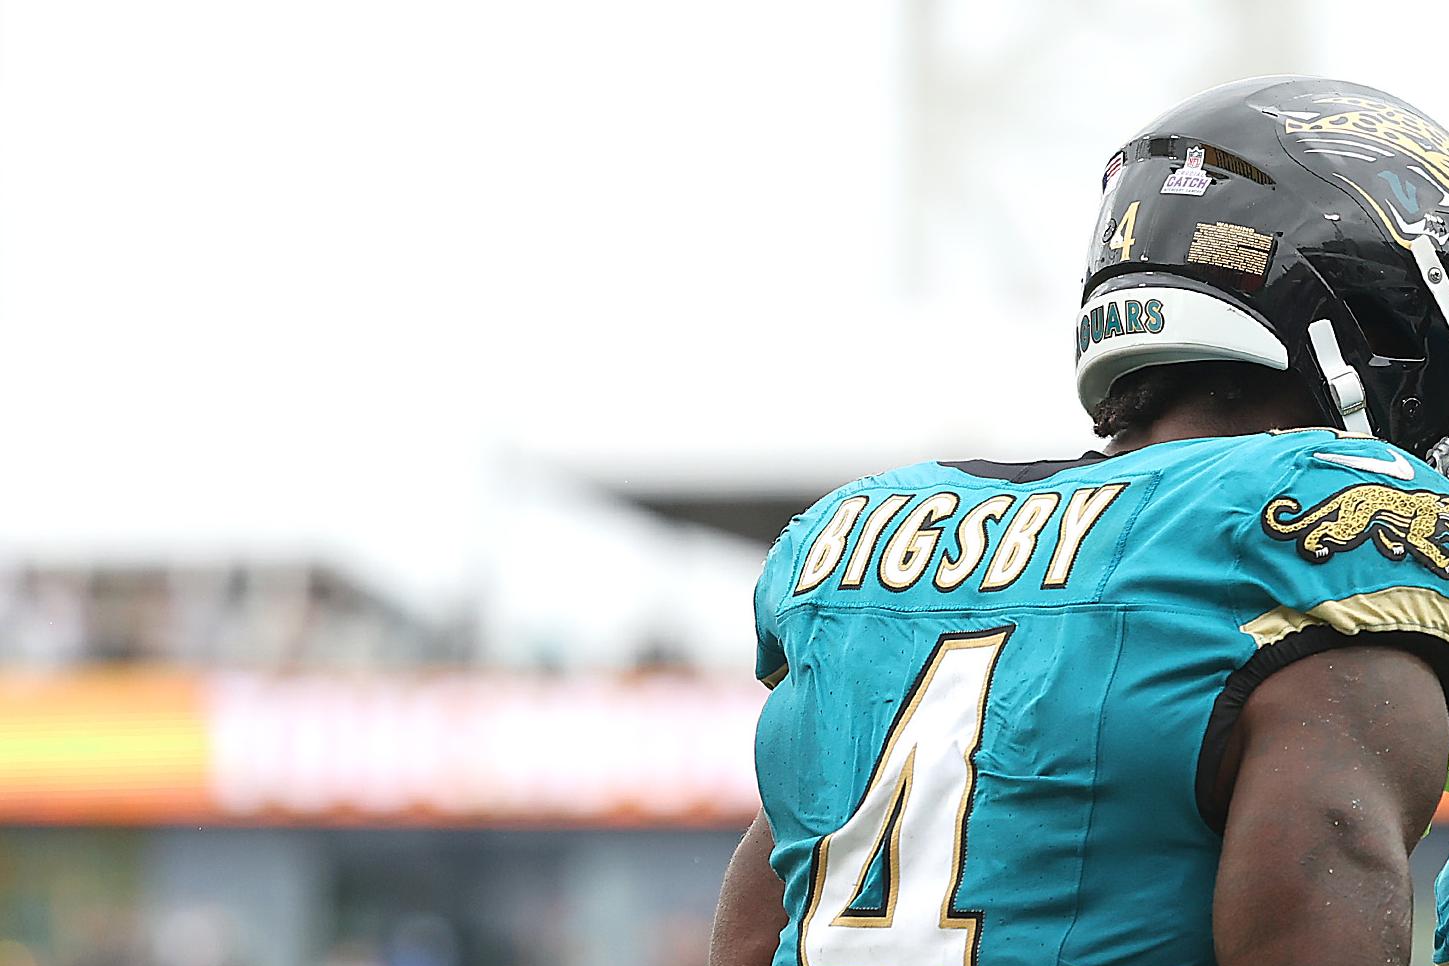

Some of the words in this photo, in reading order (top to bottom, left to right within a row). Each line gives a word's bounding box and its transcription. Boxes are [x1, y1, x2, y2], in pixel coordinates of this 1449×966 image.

[1187, 156, 1200, 166] NFL
[1166, 176, 1209, 189] CATCH
[1109, 200, 1141, 262] 4
[1216, 221, 1255, 233] WARNING
[1077, 299, 1165, 355] GUARS
[792, 482, 1132, 597] BIGSBY
